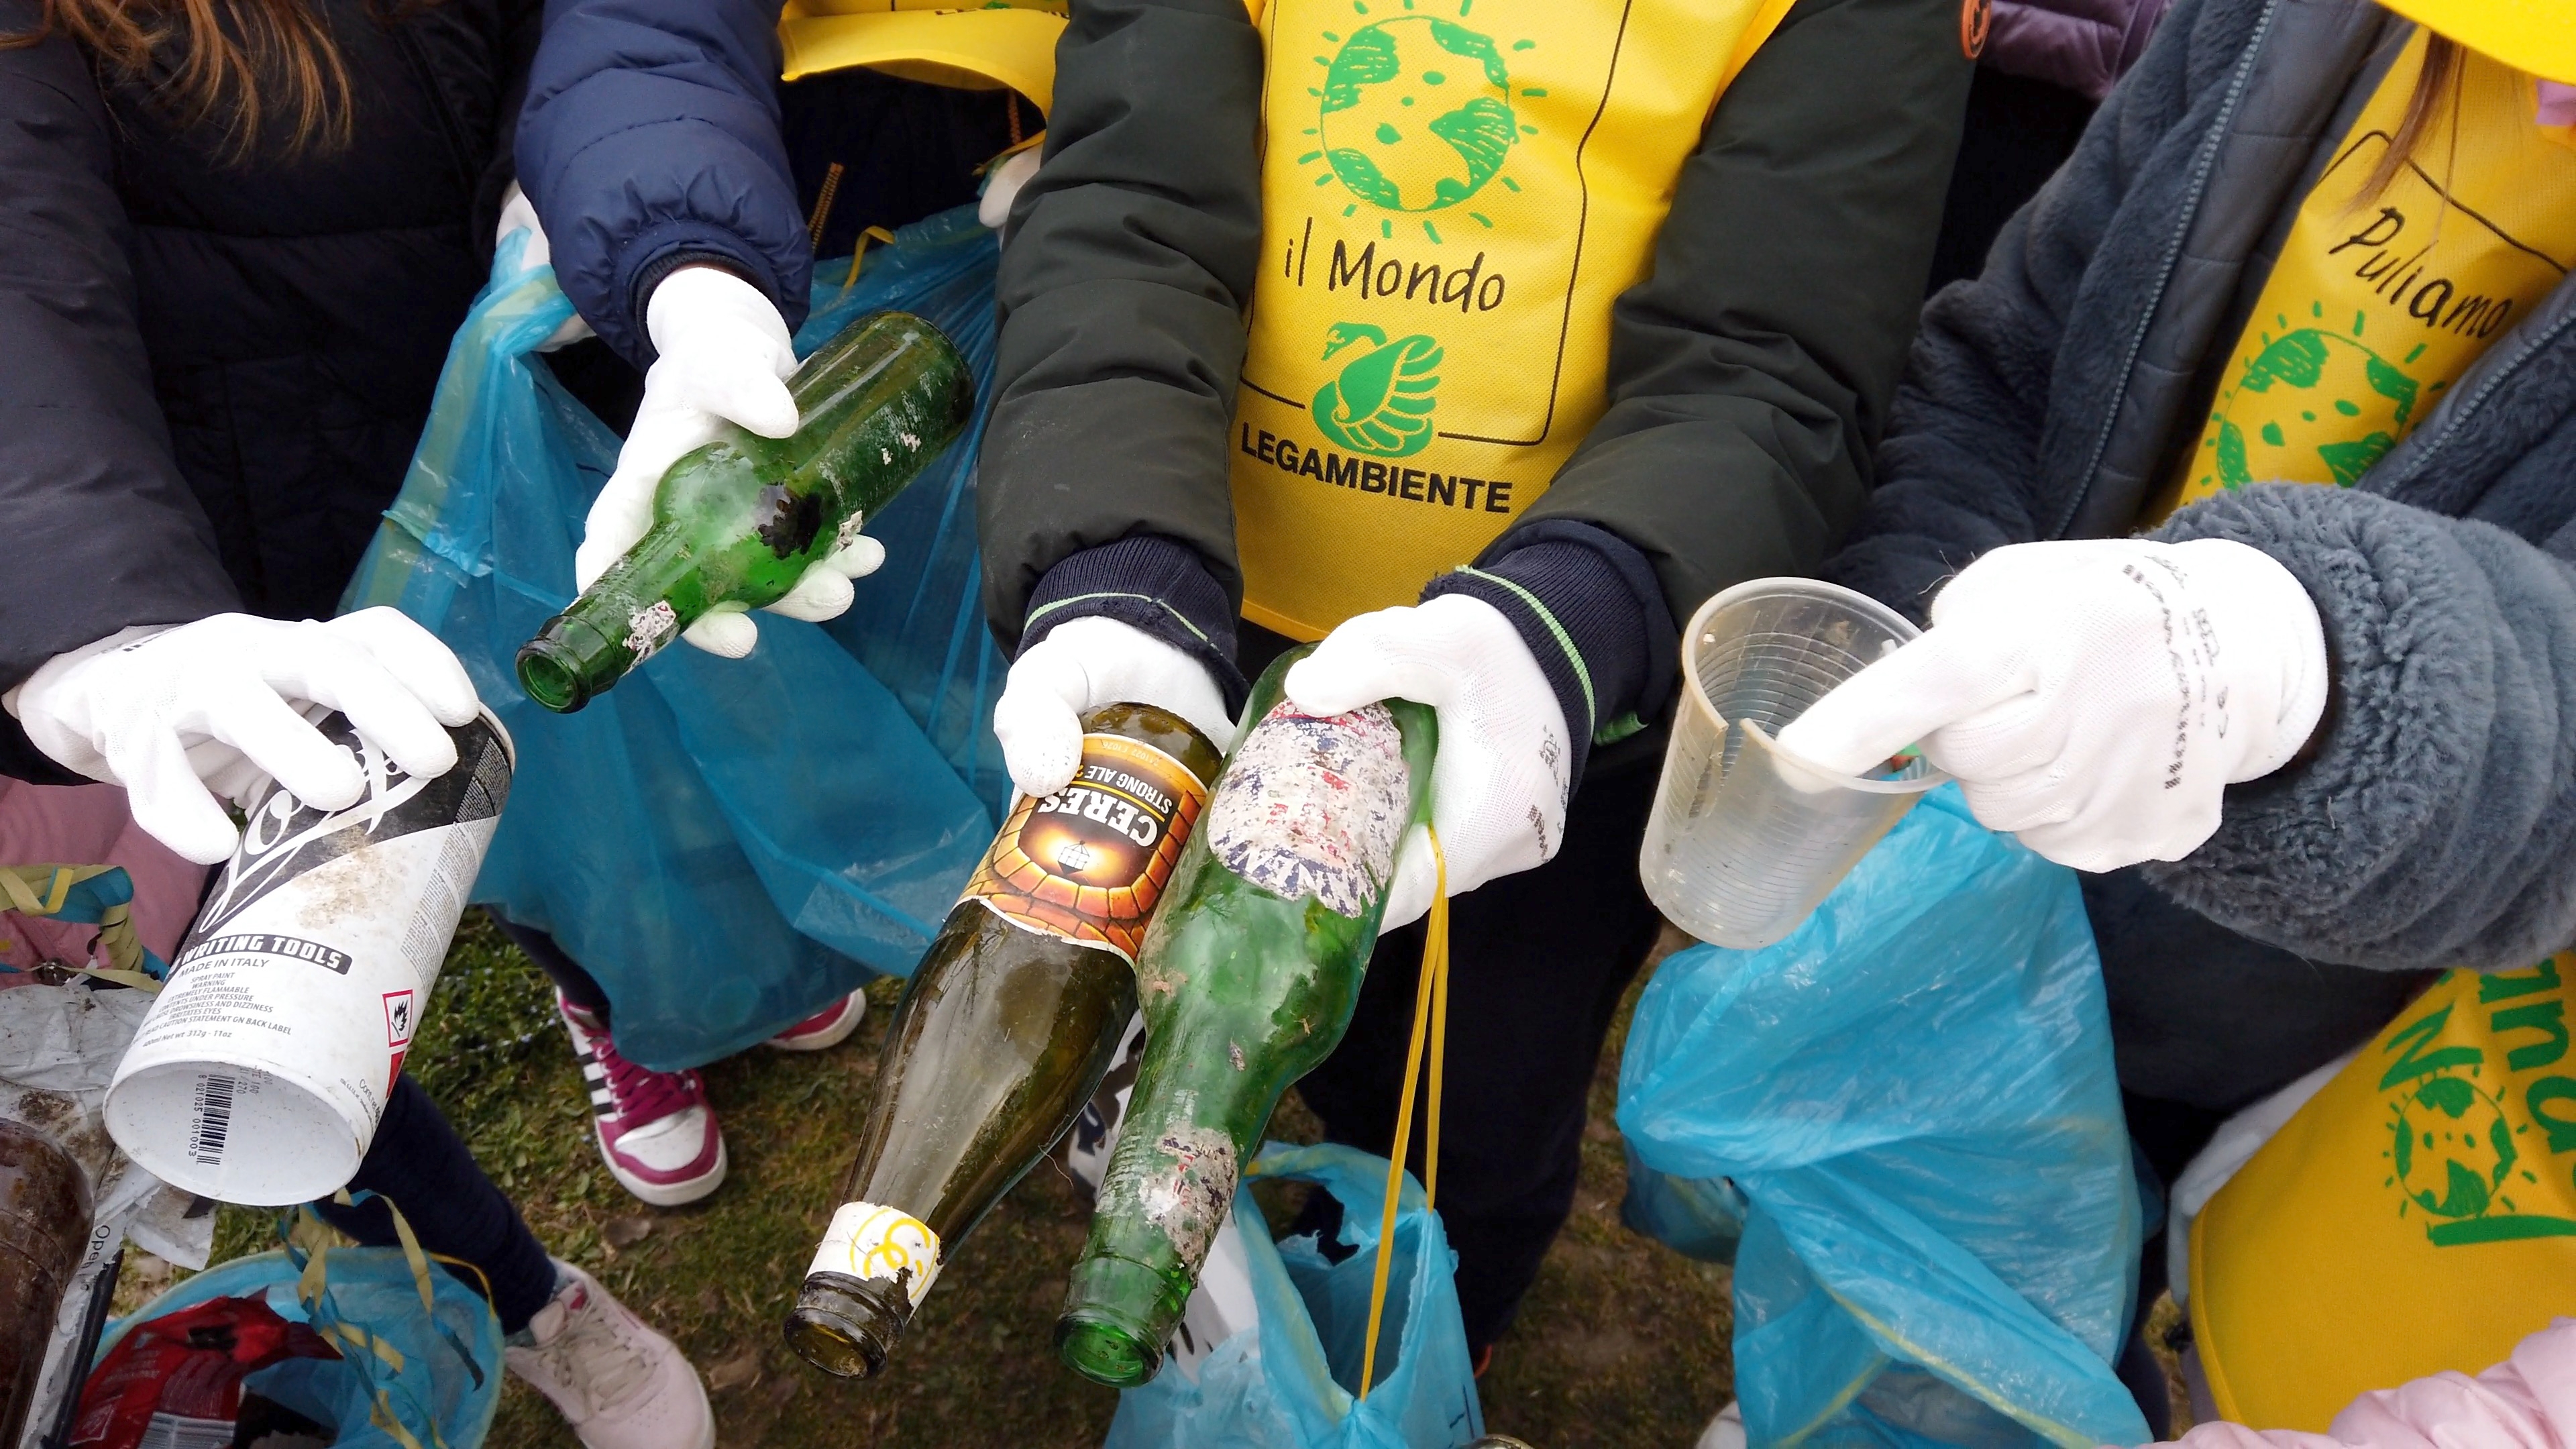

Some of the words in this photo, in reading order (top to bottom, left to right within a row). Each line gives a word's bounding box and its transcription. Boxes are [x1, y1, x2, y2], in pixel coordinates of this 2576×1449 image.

[1285, 217, 1313, 287] il
[1328, 239, 1506, 314] Mondo
[2328, 207, 2514, 339] Puliamo
[1241, 422, 1513, 513] LEGAMBIENTE
[1084, 765, 1119, 782] ALE
[1116, 773, 1173, 814] STRONG
[1038, 787, 1158, 847] CERES
[181, 935, 264, 965] WRITING
[271, 937, 342, 969] TOOLS
[178, 961, 213, 978] MADE
[213, 959, 229, 968] IN
[230, 958, 270, 968] ITALY
[190, 973, 213, 984] SPRAY
[213, 972, 236, 980] PAINT
[191, 979, 226, 989] WARNING
[168, 988, 203, 1004] EXTREMELY
[202, 986, 250, 994] FLAMMABLE
[189, 994, 214, 1003] UNDER
[214, 993, 254, 1002] PRESSURE
[168, 1008, 202, 1020] IRRITATES
[169, 1000, 215, 1014] DROWSINESS
[214, 1000, 232, 1008] AND
[232, 1001, 274, 1014] DIZZINESS
[159, 1017, 187, 1030] CAUTION
[187, 1015, 233, 1023] STATEMENT
[245, 1018, 268, 1028] BACK
[267, 1022, 292, 1036] LABEL
[186, 1030, 207, 1038] 312g
[213, 1030, 233, 1038] 11oz
[193, 1082, 206, 1113] 021025
[188, 1118, 201, 1157] 001003
